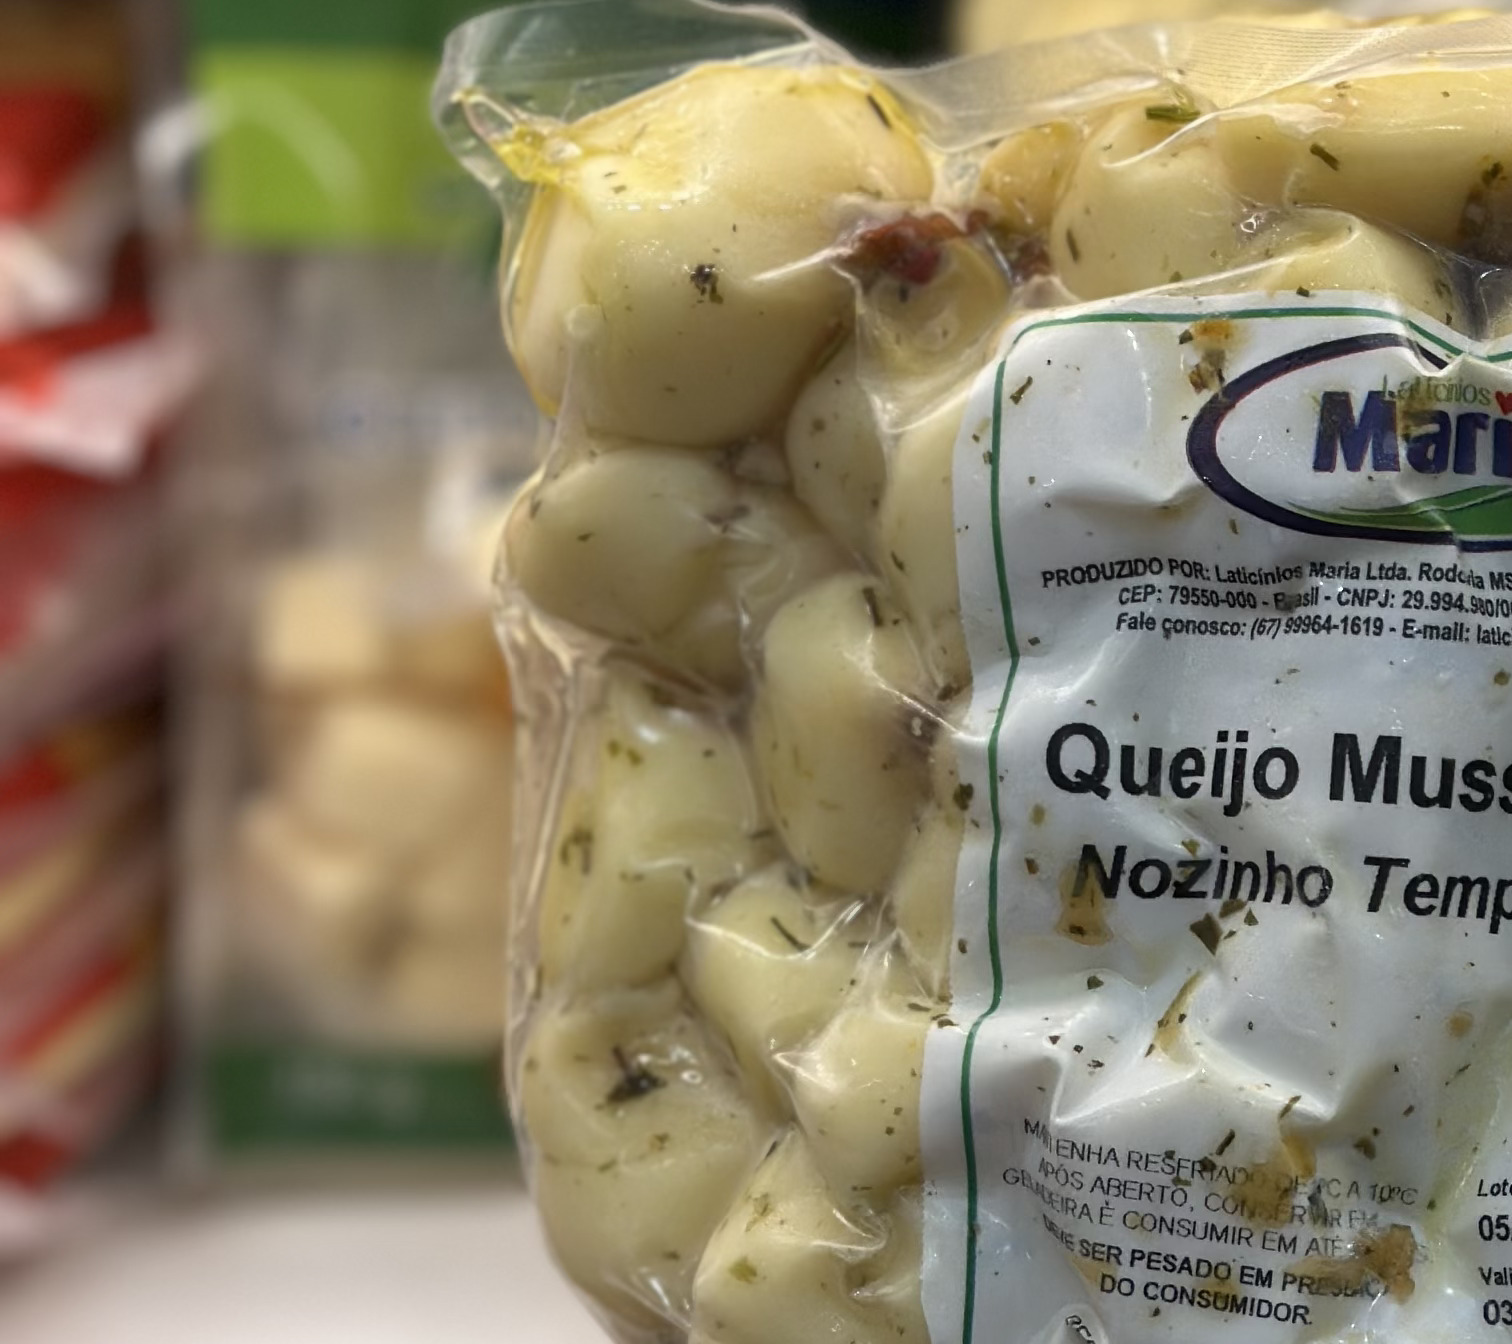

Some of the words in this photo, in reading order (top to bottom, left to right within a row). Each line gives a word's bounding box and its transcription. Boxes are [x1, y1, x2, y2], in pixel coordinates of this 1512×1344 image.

[1041, 557, 1164, 588] PRODUZIDO
[1167, 558, 1211, 582] POR:
[1214, 564, 1303, 587] Laticínios
[1308, 561, 1361, 581] Maria
[1365, 561, 1412, 581] Ltda.
[1118, 584, 1163, 606] CEP:
[1168, 585, 1258, 610] 79550-000
[1336, 587, 1396, 609] CNPJ:
[1115, 611, 1157, 633] Fale
[1161, 616, 1247, 637] conosco:
[1250, 617, 1281, 641] (67)
[1283, 614, 1384, 638] 99964-1619
[1401, 618, 1470, 643] E-mail:
[1046, 721, 1300, 818] Queijo
[1072, 843, 1335, 910] Nozinho
[1089, 1175, 1195, 1213] ABERTO,
[1121, 1209, 1254, 1248] CONSUMIR
[1261, 1229, 1298, 1255] EM
[1078, 1238, 1123, 1266] SER
[1129, 1248, 1232, 1281] PESADO
[1239, 1264, 1273, 1289] EM
[1099, 1271, 1135, 1297] DO
[1143, 1280, 1314, 1327] CONSUMIDOR.
